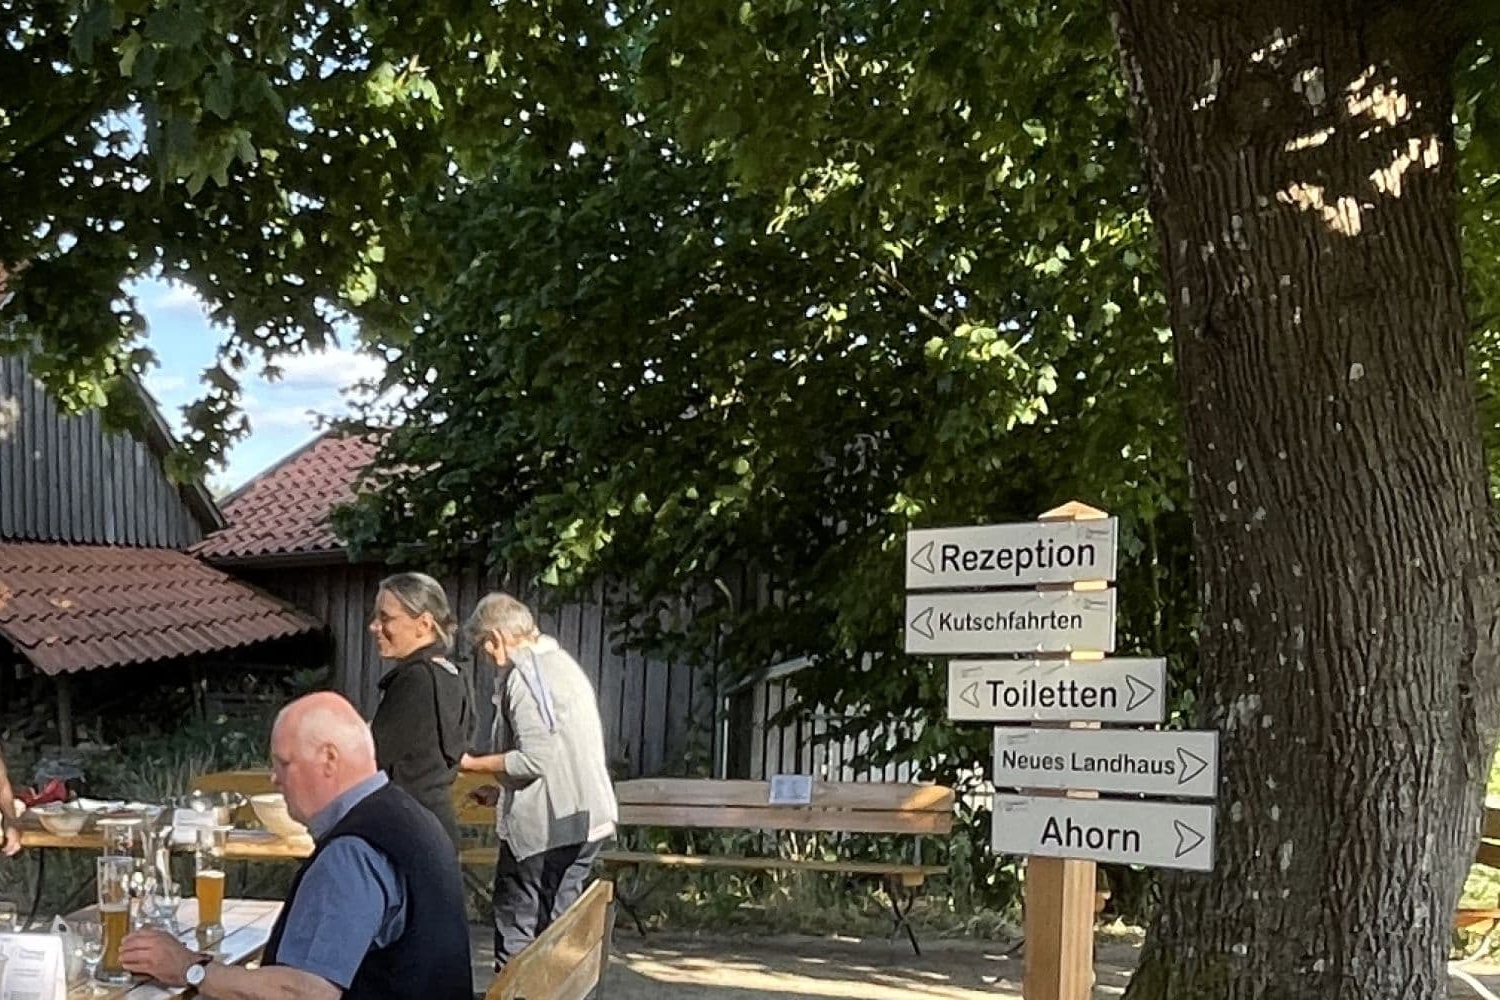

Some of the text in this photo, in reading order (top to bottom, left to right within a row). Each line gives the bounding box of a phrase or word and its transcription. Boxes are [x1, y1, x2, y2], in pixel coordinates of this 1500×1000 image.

[940, 539, 1096, 576] Rezeption
[939, 610, 1083, 632] Kutschfahrten
[986, 679, 1117, 708] Toiletten
[1002, 750, 1176, 776] Neues Landhaus
[1040, 817, 1140, 853] Ahorn
